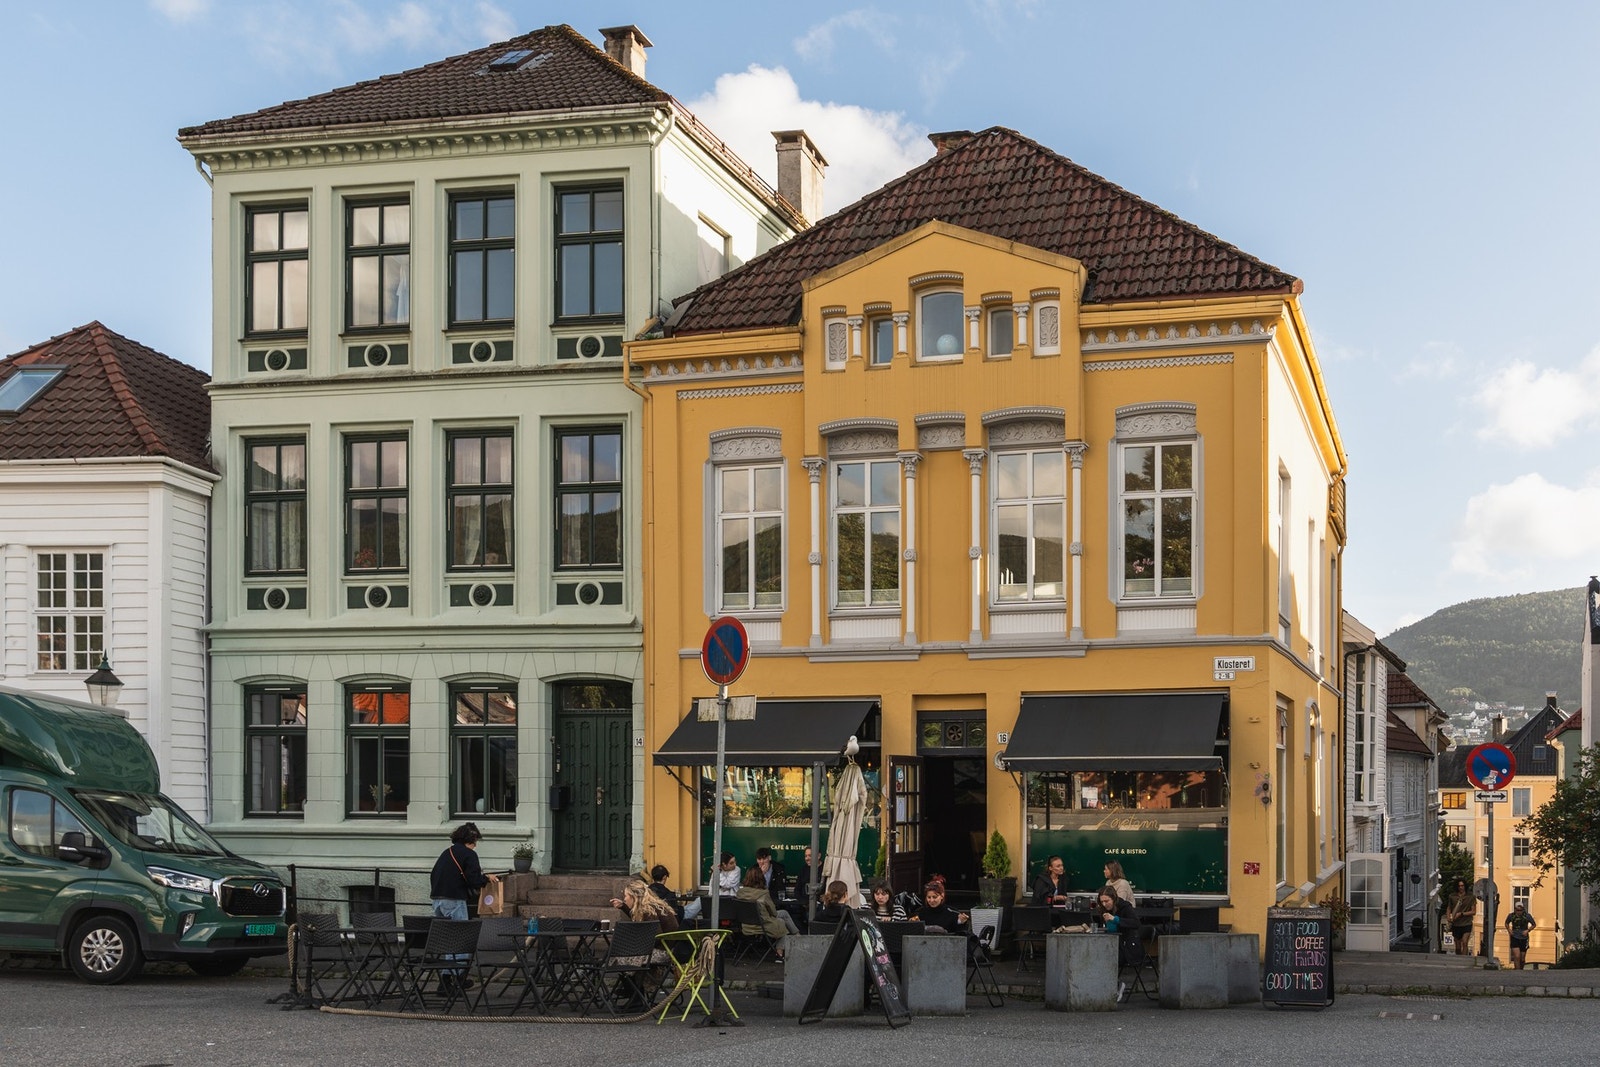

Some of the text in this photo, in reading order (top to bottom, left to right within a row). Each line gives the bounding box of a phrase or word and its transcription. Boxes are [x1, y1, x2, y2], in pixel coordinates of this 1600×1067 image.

[1217, 660, 1250, 669] Klosteret
[999, 733, 1007, 743] 16
[1273, 922, 1320, 936] GOOD FOOD
[1295, 936, 1325, 950] COFFEE
[1266, 972, 1324, 990] GOOD TIMES
